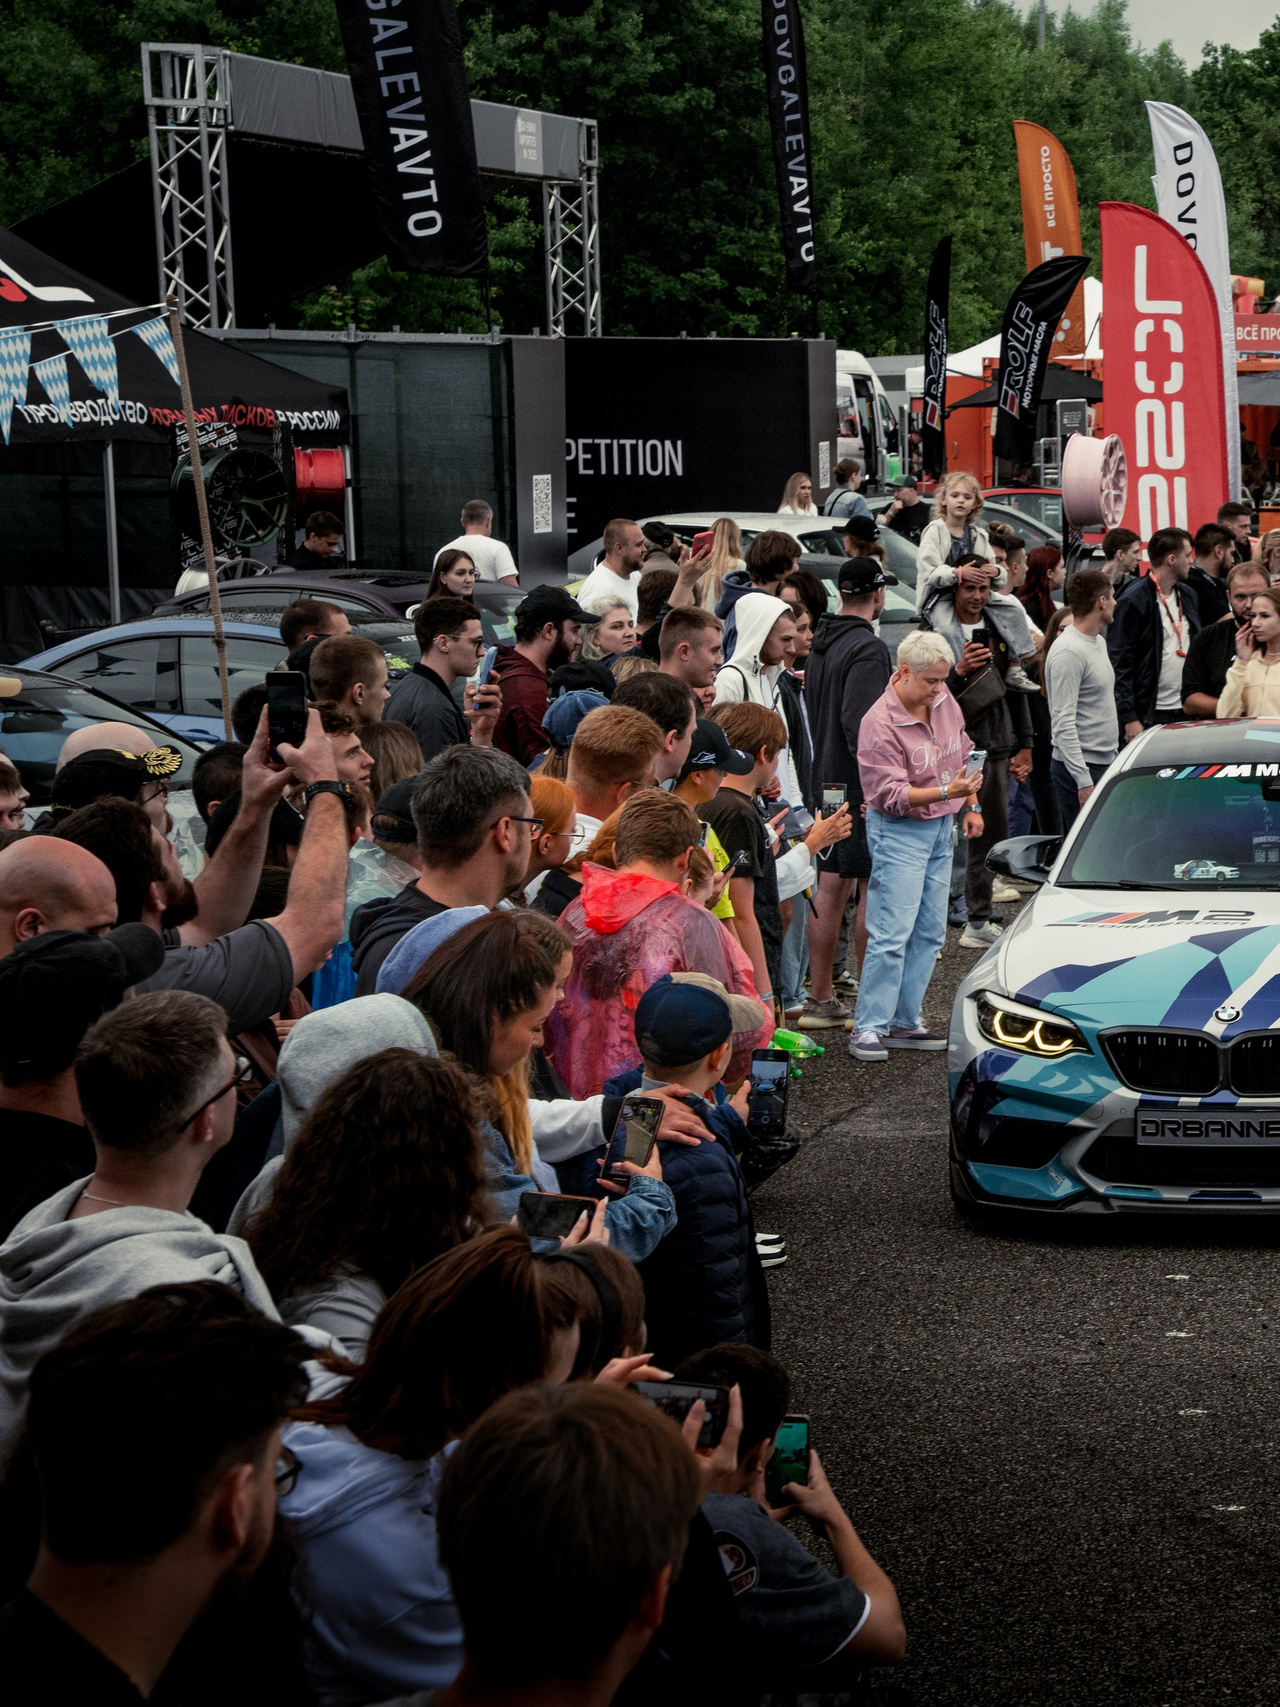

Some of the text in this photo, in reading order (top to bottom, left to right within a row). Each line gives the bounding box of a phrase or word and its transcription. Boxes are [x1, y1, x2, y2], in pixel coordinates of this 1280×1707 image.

[1040, 146, 1054, 202] ПРОСТО
[1236, 324, 1259, 341] ВСЁ
[285, 409, 341, 431] РОССИИ
